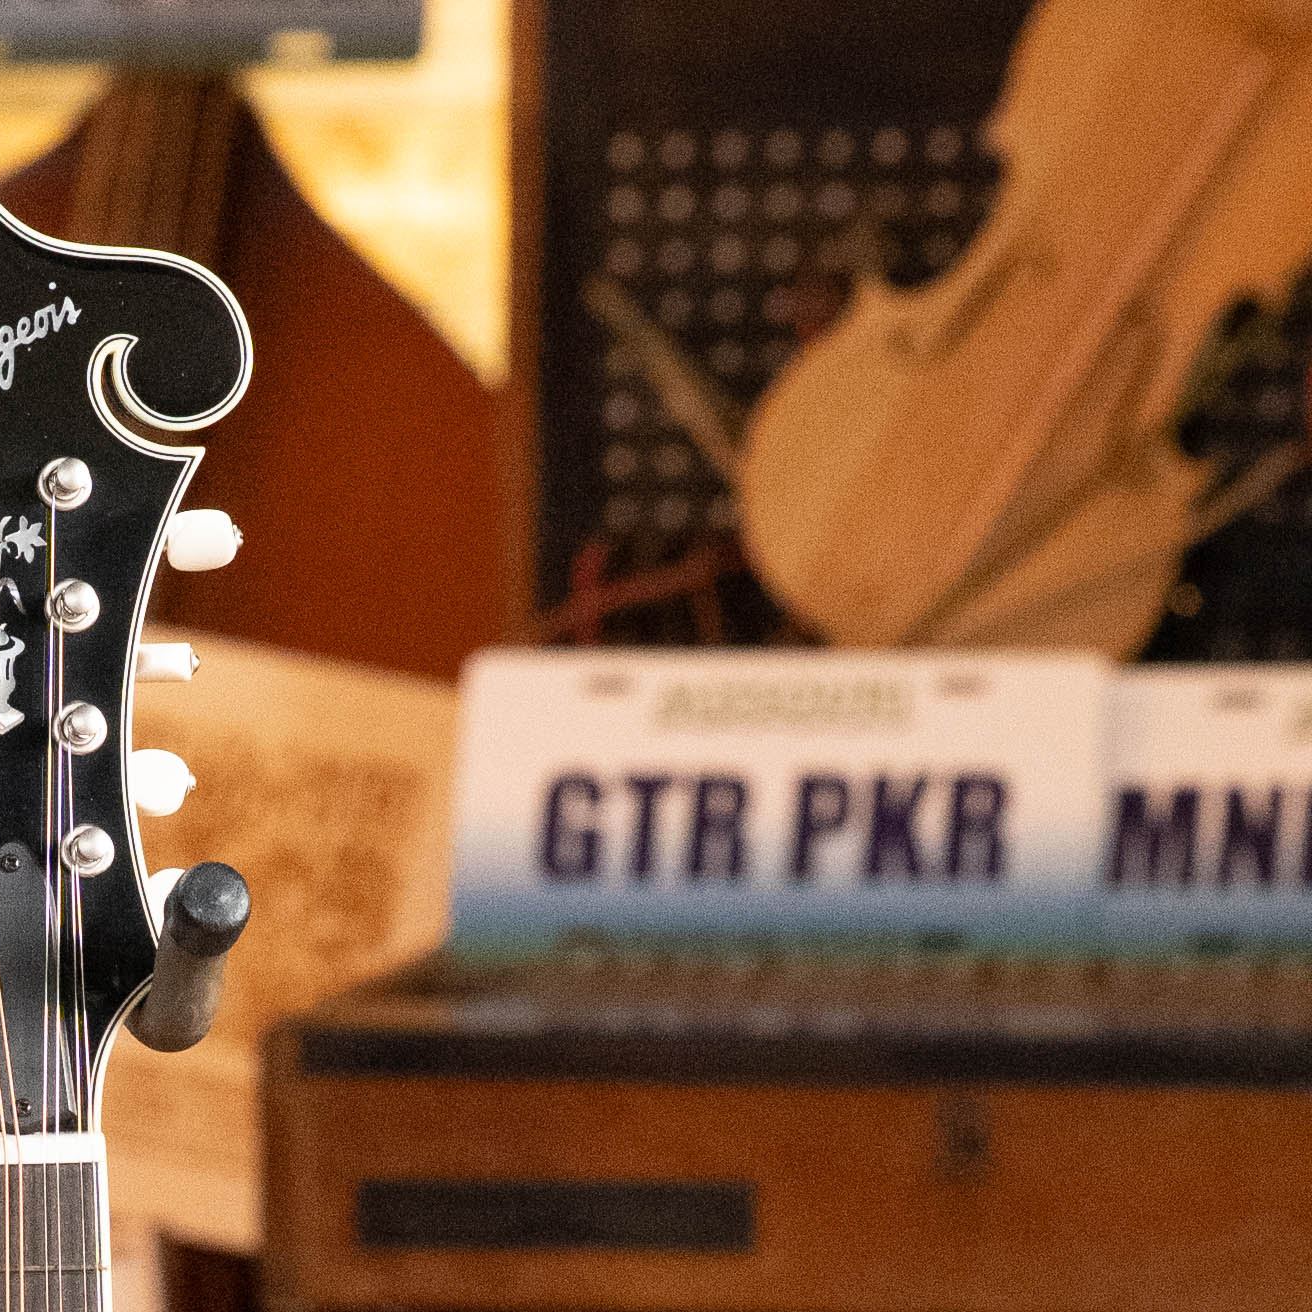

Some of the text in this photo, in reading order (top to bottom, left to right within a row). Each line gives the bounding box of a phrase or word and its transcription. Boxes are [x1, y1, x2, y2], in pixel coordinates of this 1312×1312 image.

[540, 768, 750, 882] GTR
[791, 768, 1010, 882] PKR
[1108, 785, 1312, 885] MN
